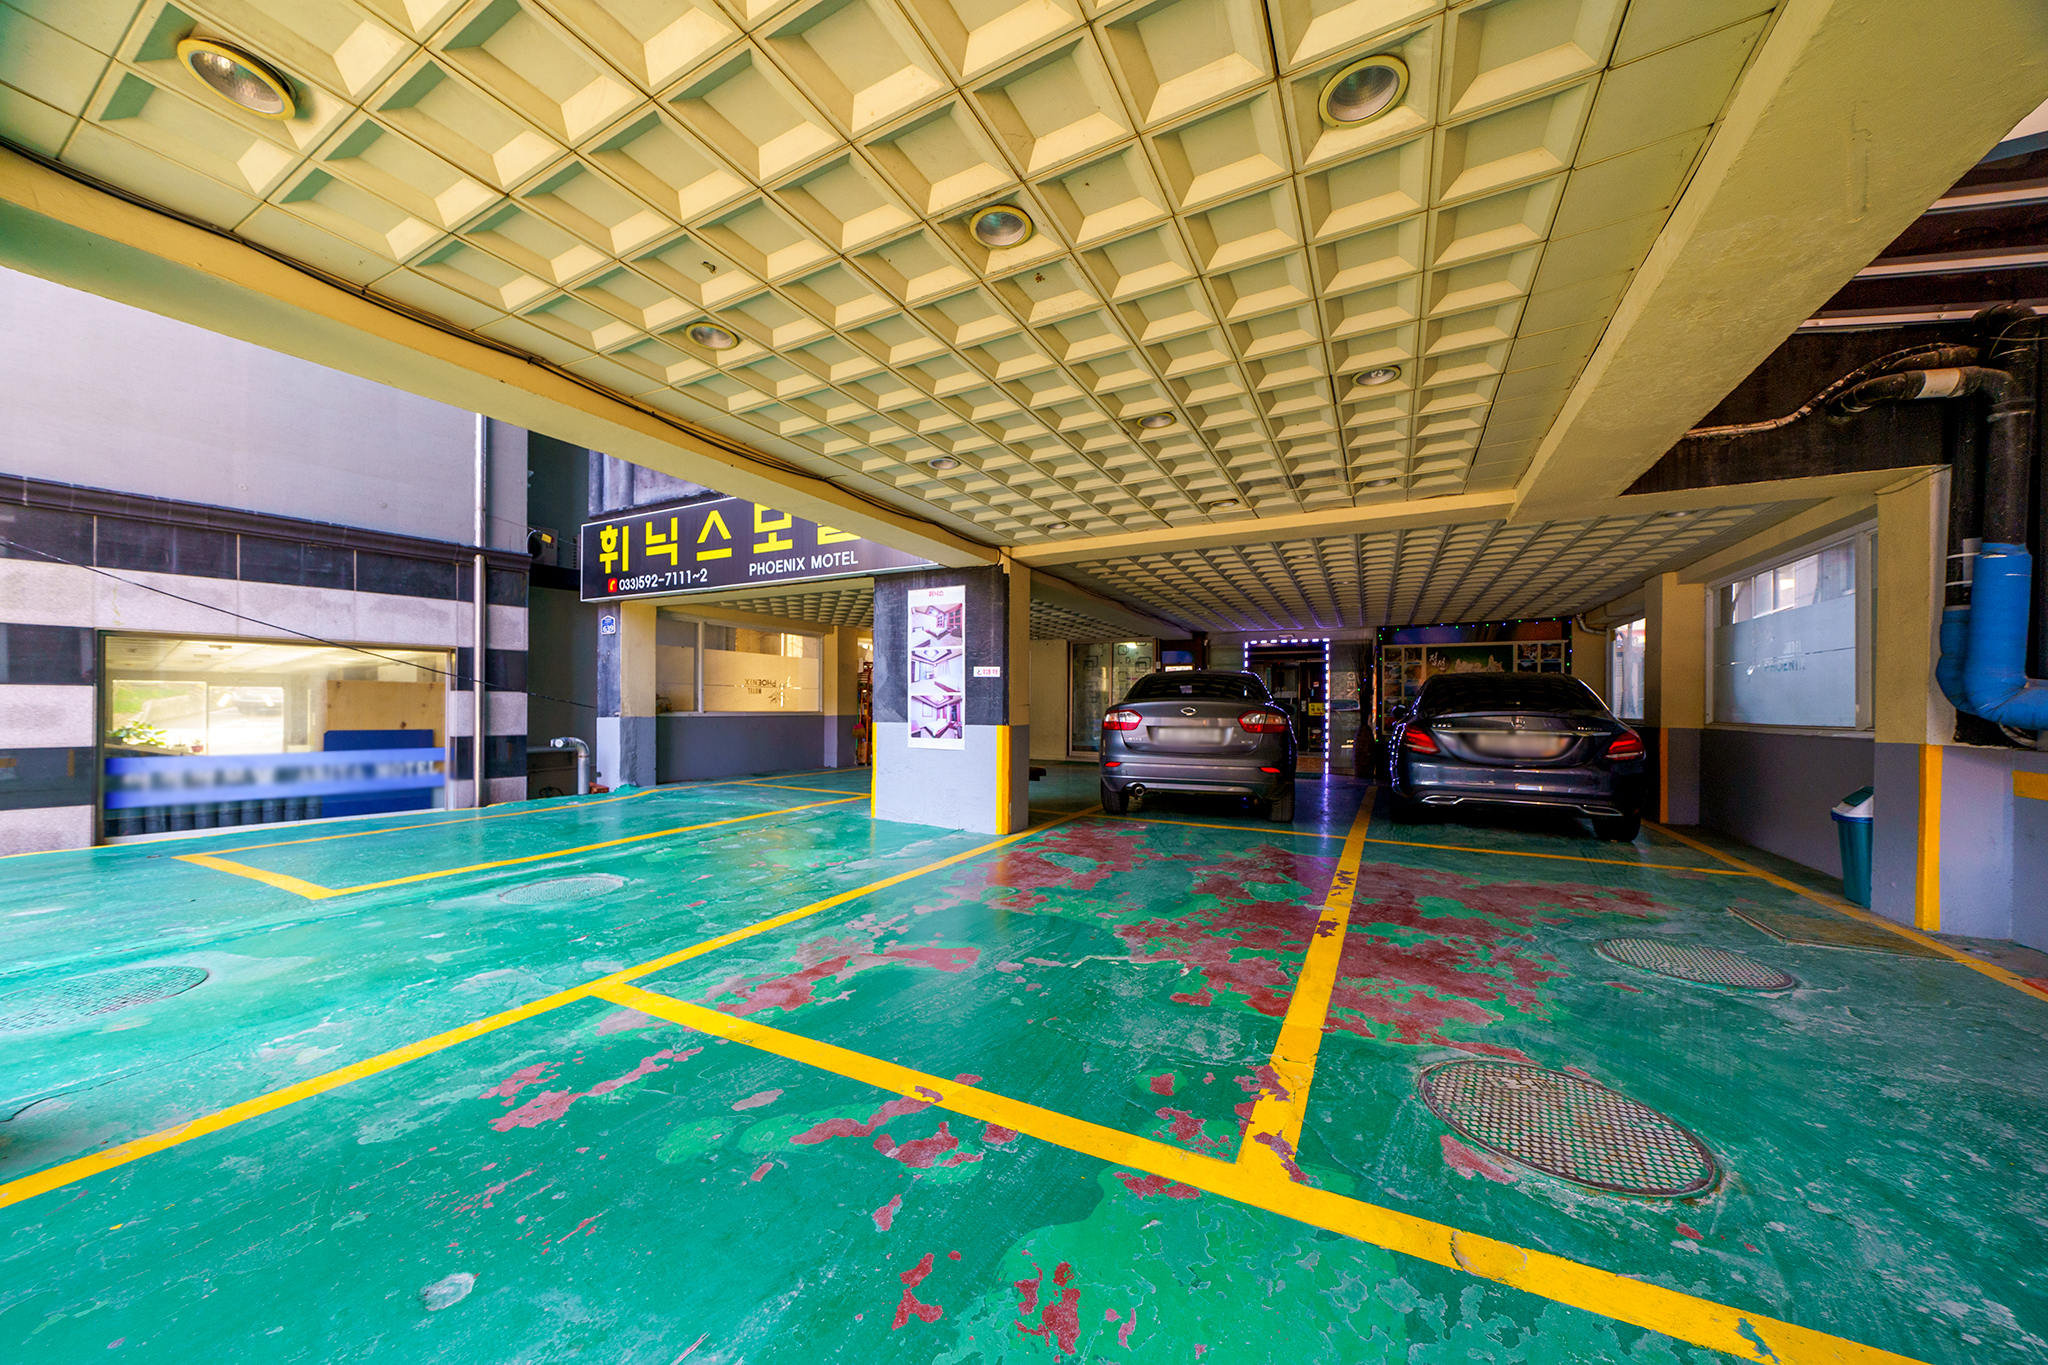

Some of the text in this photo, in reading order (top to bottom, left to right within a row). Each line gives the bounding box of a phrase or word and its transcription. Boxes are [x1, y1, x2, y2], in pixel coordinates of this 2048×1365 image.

[749, 550, 859, 576] PHOENIX MOTEL
[619, 568, 708, 591] 033)592-7111~2
[744, 678, 777, 688] PHOENIX
